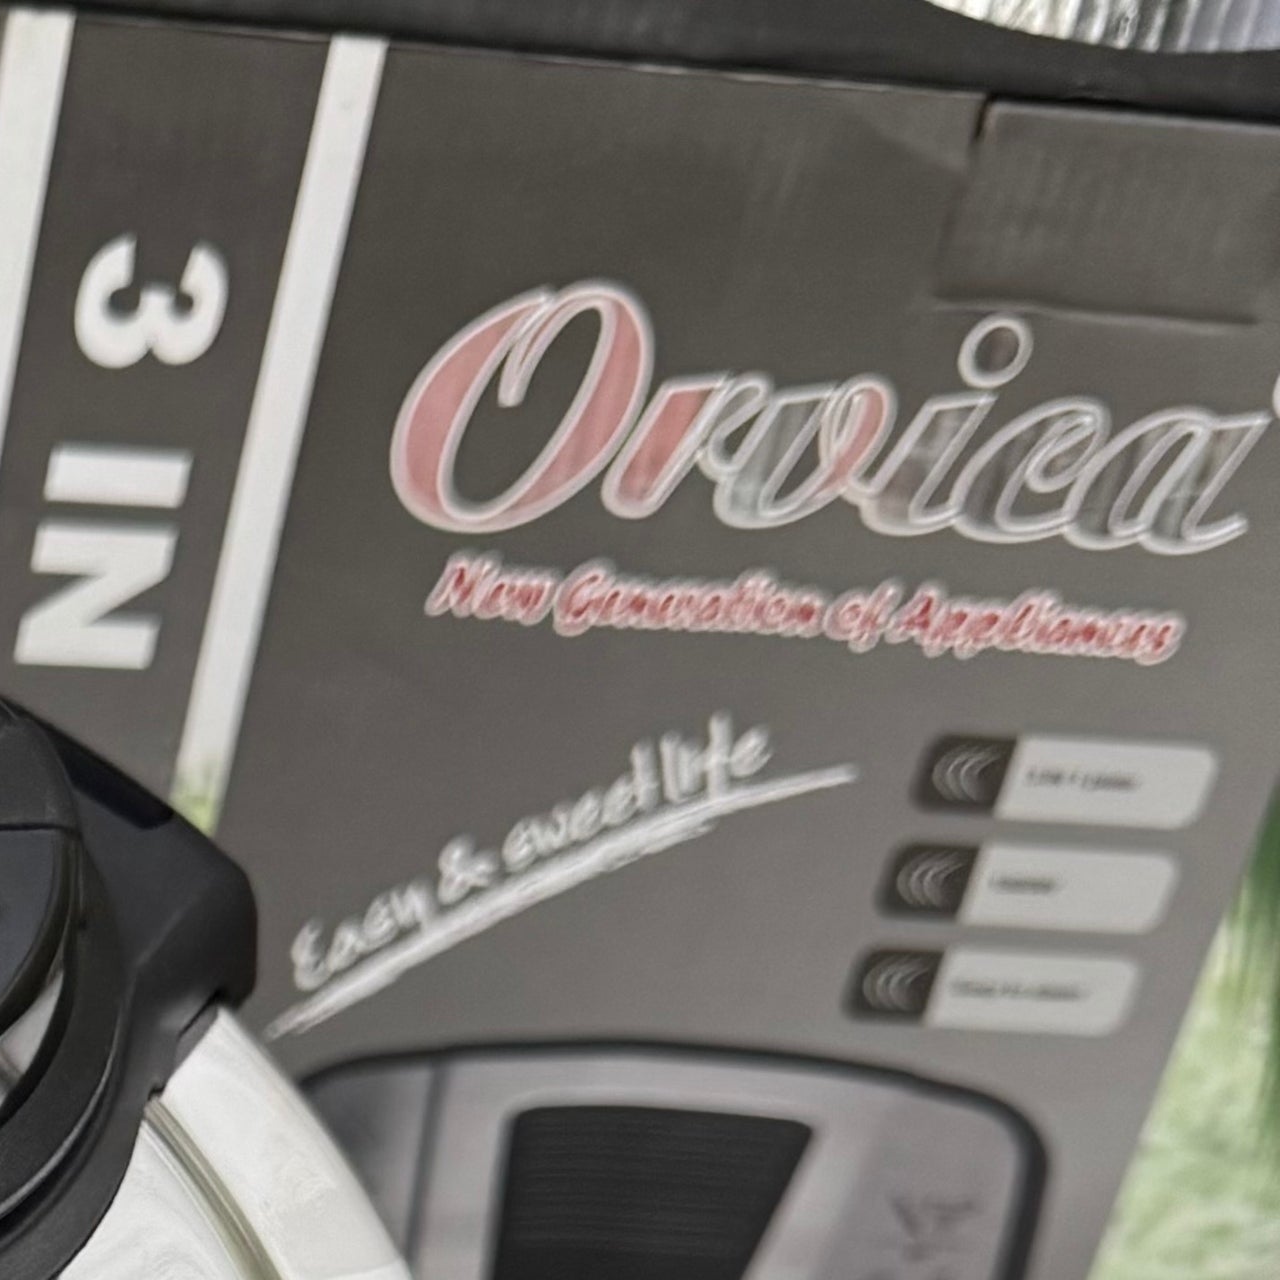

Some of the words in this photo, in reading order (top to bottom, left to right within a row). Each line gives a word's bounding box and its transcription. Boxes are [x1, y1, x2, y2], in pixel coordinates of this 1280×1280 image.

[72, 234, 230, 370] 3
[390, 277, 1269, 555] Orvica
[12, 441, 194, 671] IN
[425, 550, 557, 625] New
[553, 560, 823, 635] Generation
[824, 577, 906, 652] of
[886, 581, 1188, 666] Appliances
[290, 877, 433, 992] Easy
[439, 833, 500, 905] &
[503, 740, 657, 873] sweet
[659, 708, 774, 803] life
